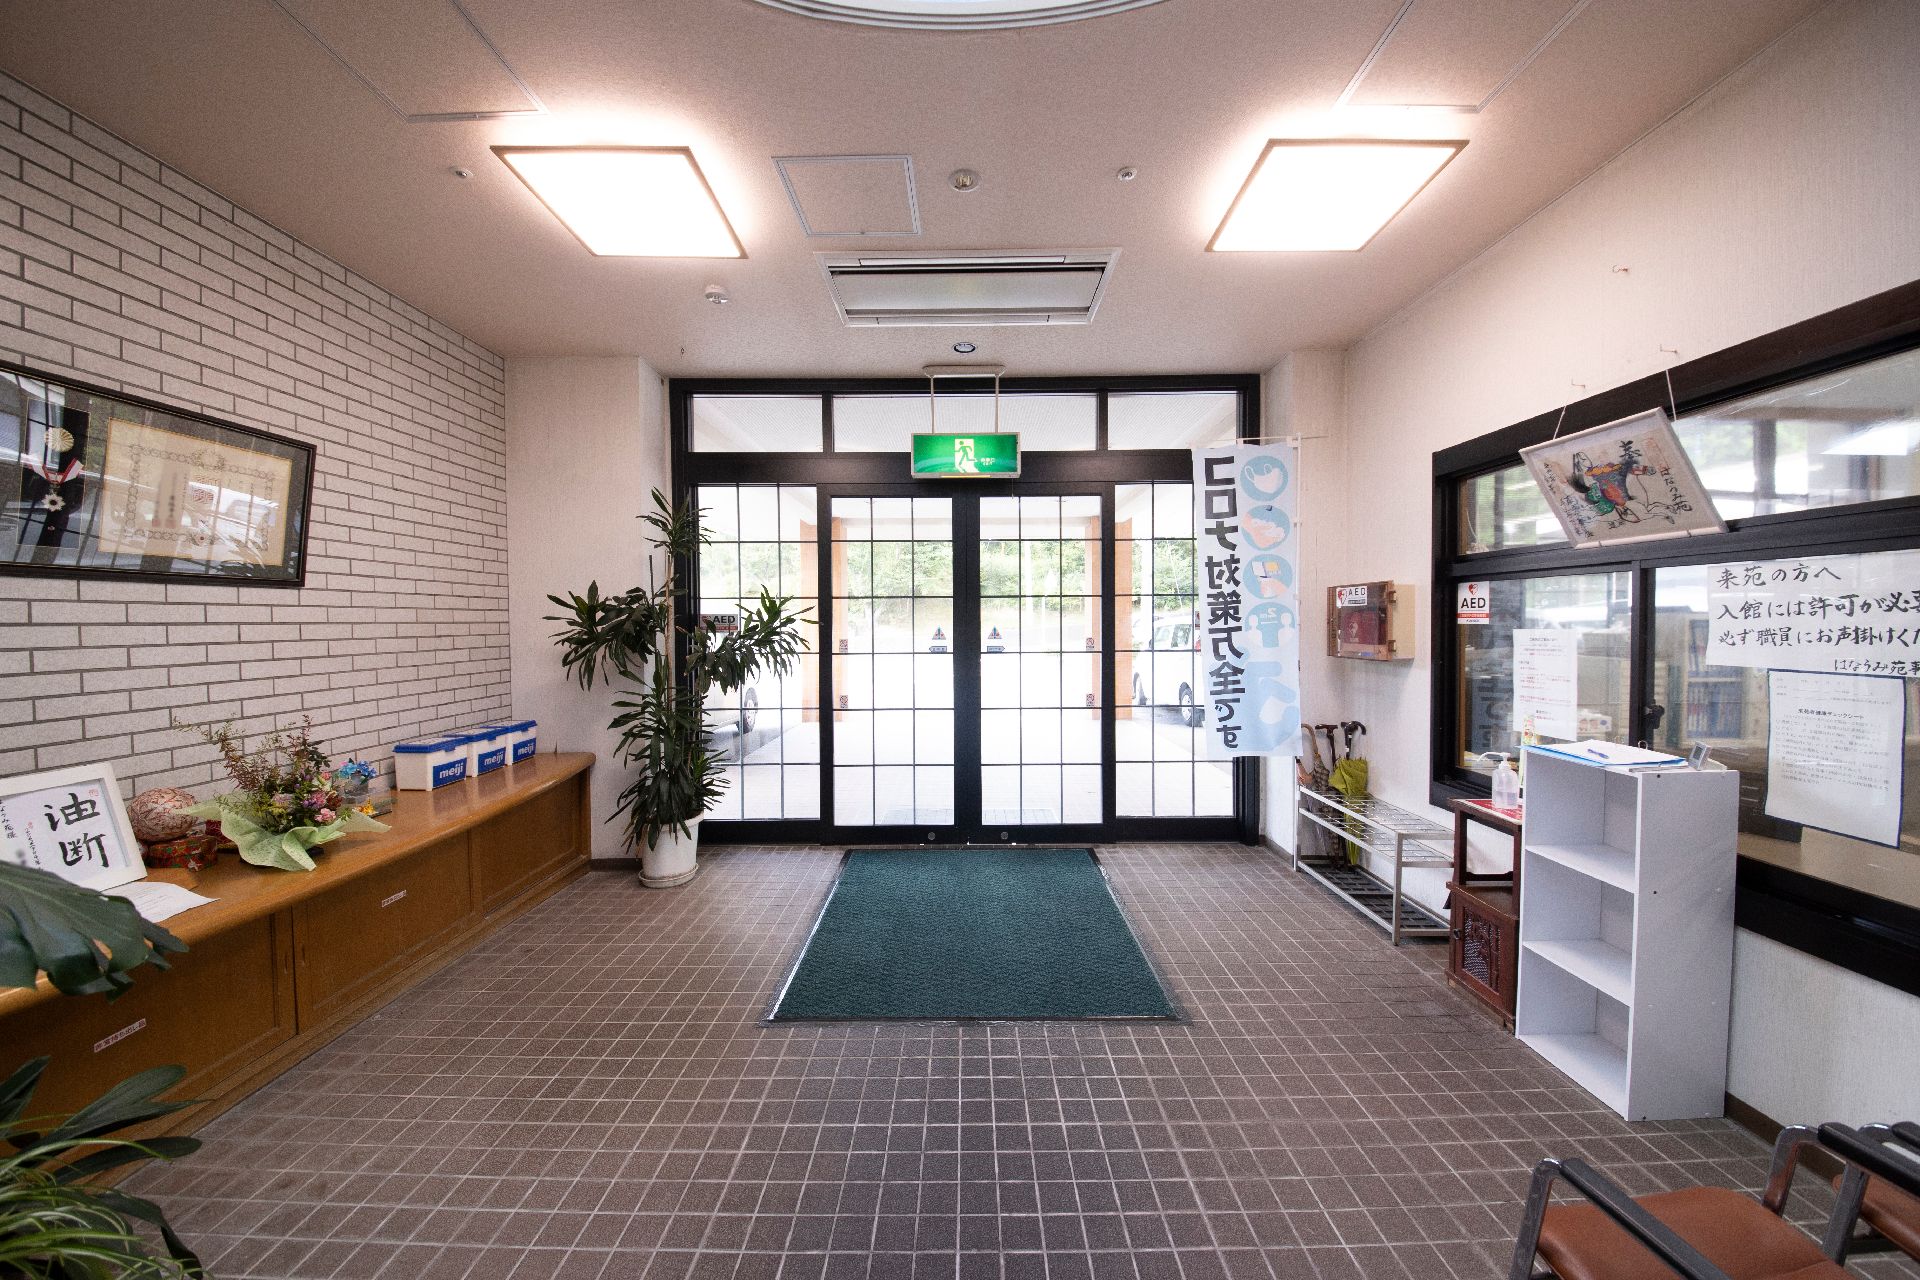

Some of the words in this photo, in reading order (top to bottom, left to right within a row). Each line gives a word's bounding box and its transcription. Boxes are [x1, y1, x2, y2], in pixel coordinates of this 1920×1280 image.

[1716, 563, 1842, 589] 来苑の方へ
[1349, 587, 1366, 596] AED
[1461, 597, 1486, 609] AED
[713, 615, 736, 624] AED
[517, 743, 534, 756] meiji
[484, 751, 504, 766] meiji
[439, 762, 464, 779] meiji
[44, 792, 109, 868] 油断
